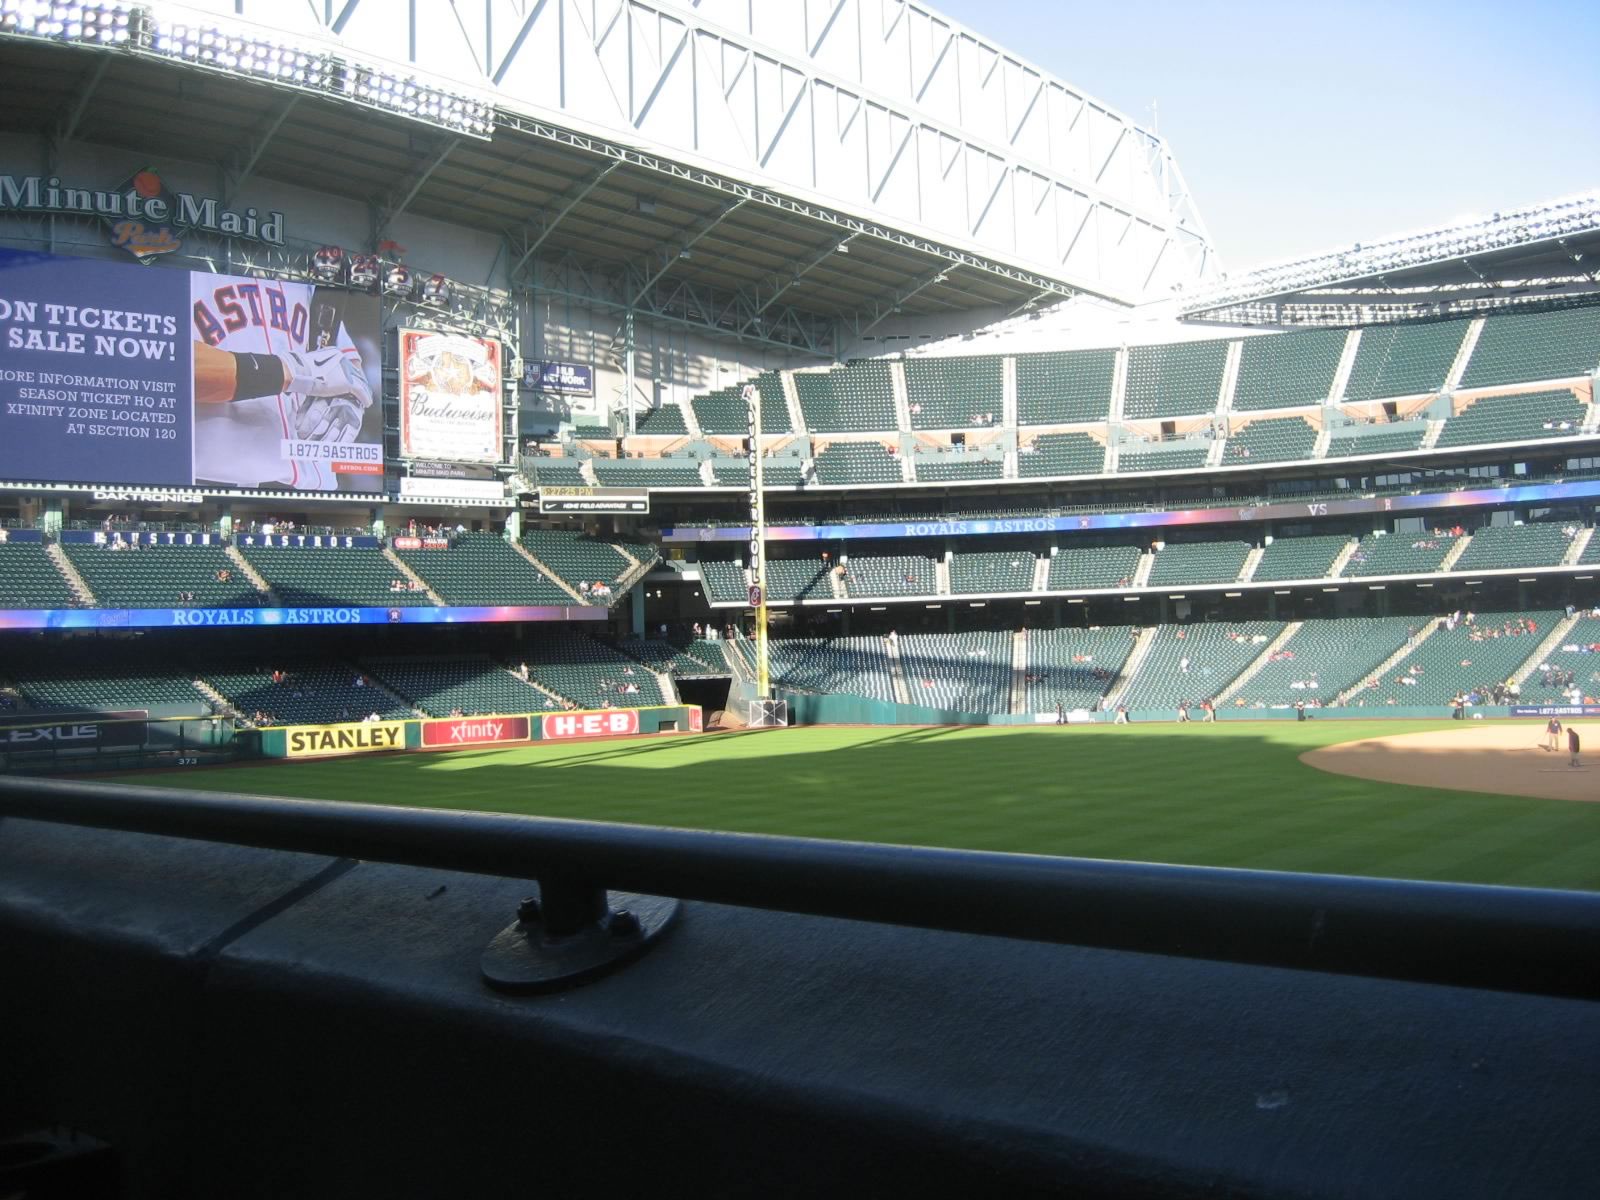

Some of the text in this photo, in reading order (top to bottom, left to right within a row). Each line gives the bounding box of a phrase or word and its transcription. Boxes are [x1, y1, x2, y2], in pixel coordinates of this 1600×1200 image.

[0, 175, 285, 245] Minute Maid
[45, 304, 177, 335] TICKETS
[194, 284, 307, 346] ASTRO
[9, 328, 176, 361] SALE NOW!
[39, 373, 139, 391] INFORMATION
[142, 381, 177, 393] VISIT
[19, 388, 177, 409] SEASON TICKET HQ AT
[408, 391, 494, 421] Budweiser
[8, 403, 176, 424] XFINITY ZONE LOCATED
[66, 423, 177, 440] AT SECTION 120
[94, 491, 203, 503] DAKTRONICS
[1307, 504, 1328, 516] VS
[905, 522, 968, 537] ROYALS
[993, 519, 1056, 533] ASTROS
[264, 535, 353, 548] ASTROS
[172, 609, 254, 625] ROYALS
[286, 608, 361, 623] ASTROS
[451, 720, 503, 743] xfinity
[556, 712, 629, 736] H-E-B
[291, 726, 400, 752] STANLEY
[178, 757, 197, 766] 373
